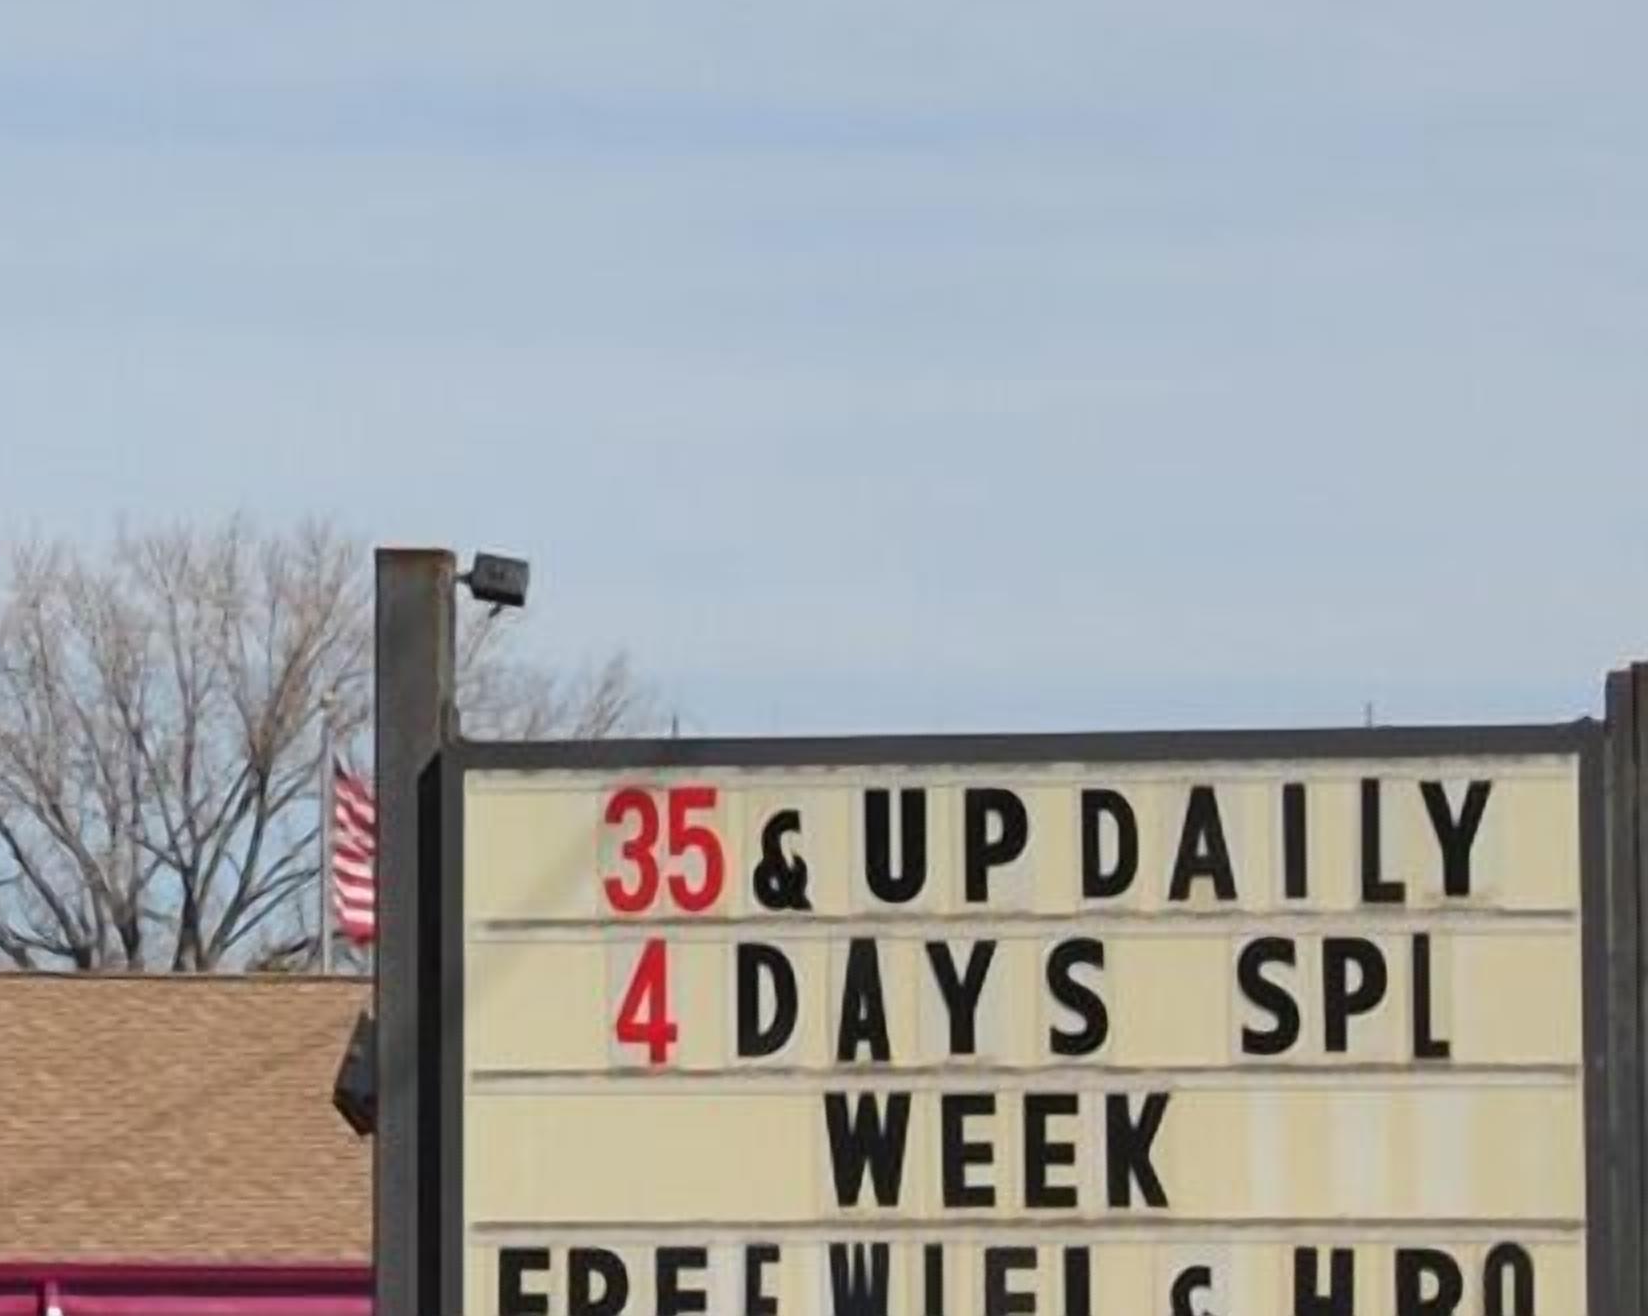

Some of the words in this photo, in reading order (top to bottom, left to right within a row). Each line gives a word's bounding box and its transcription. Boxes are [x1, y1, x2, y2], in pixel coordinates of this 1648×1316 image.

[603, 786, 725, 913] 35
[752, 809, 813, 911] &
[864, 787, 1029, 904] UP
[1081, 778, 1493, 904] DAILY
[615, 937, 678, 1064] 4
[736, 936, 1110, 1063] DAYS
[1235, 934, 1452, 1060] SPL
[823, 1091, 1171, 1209] WEEK
